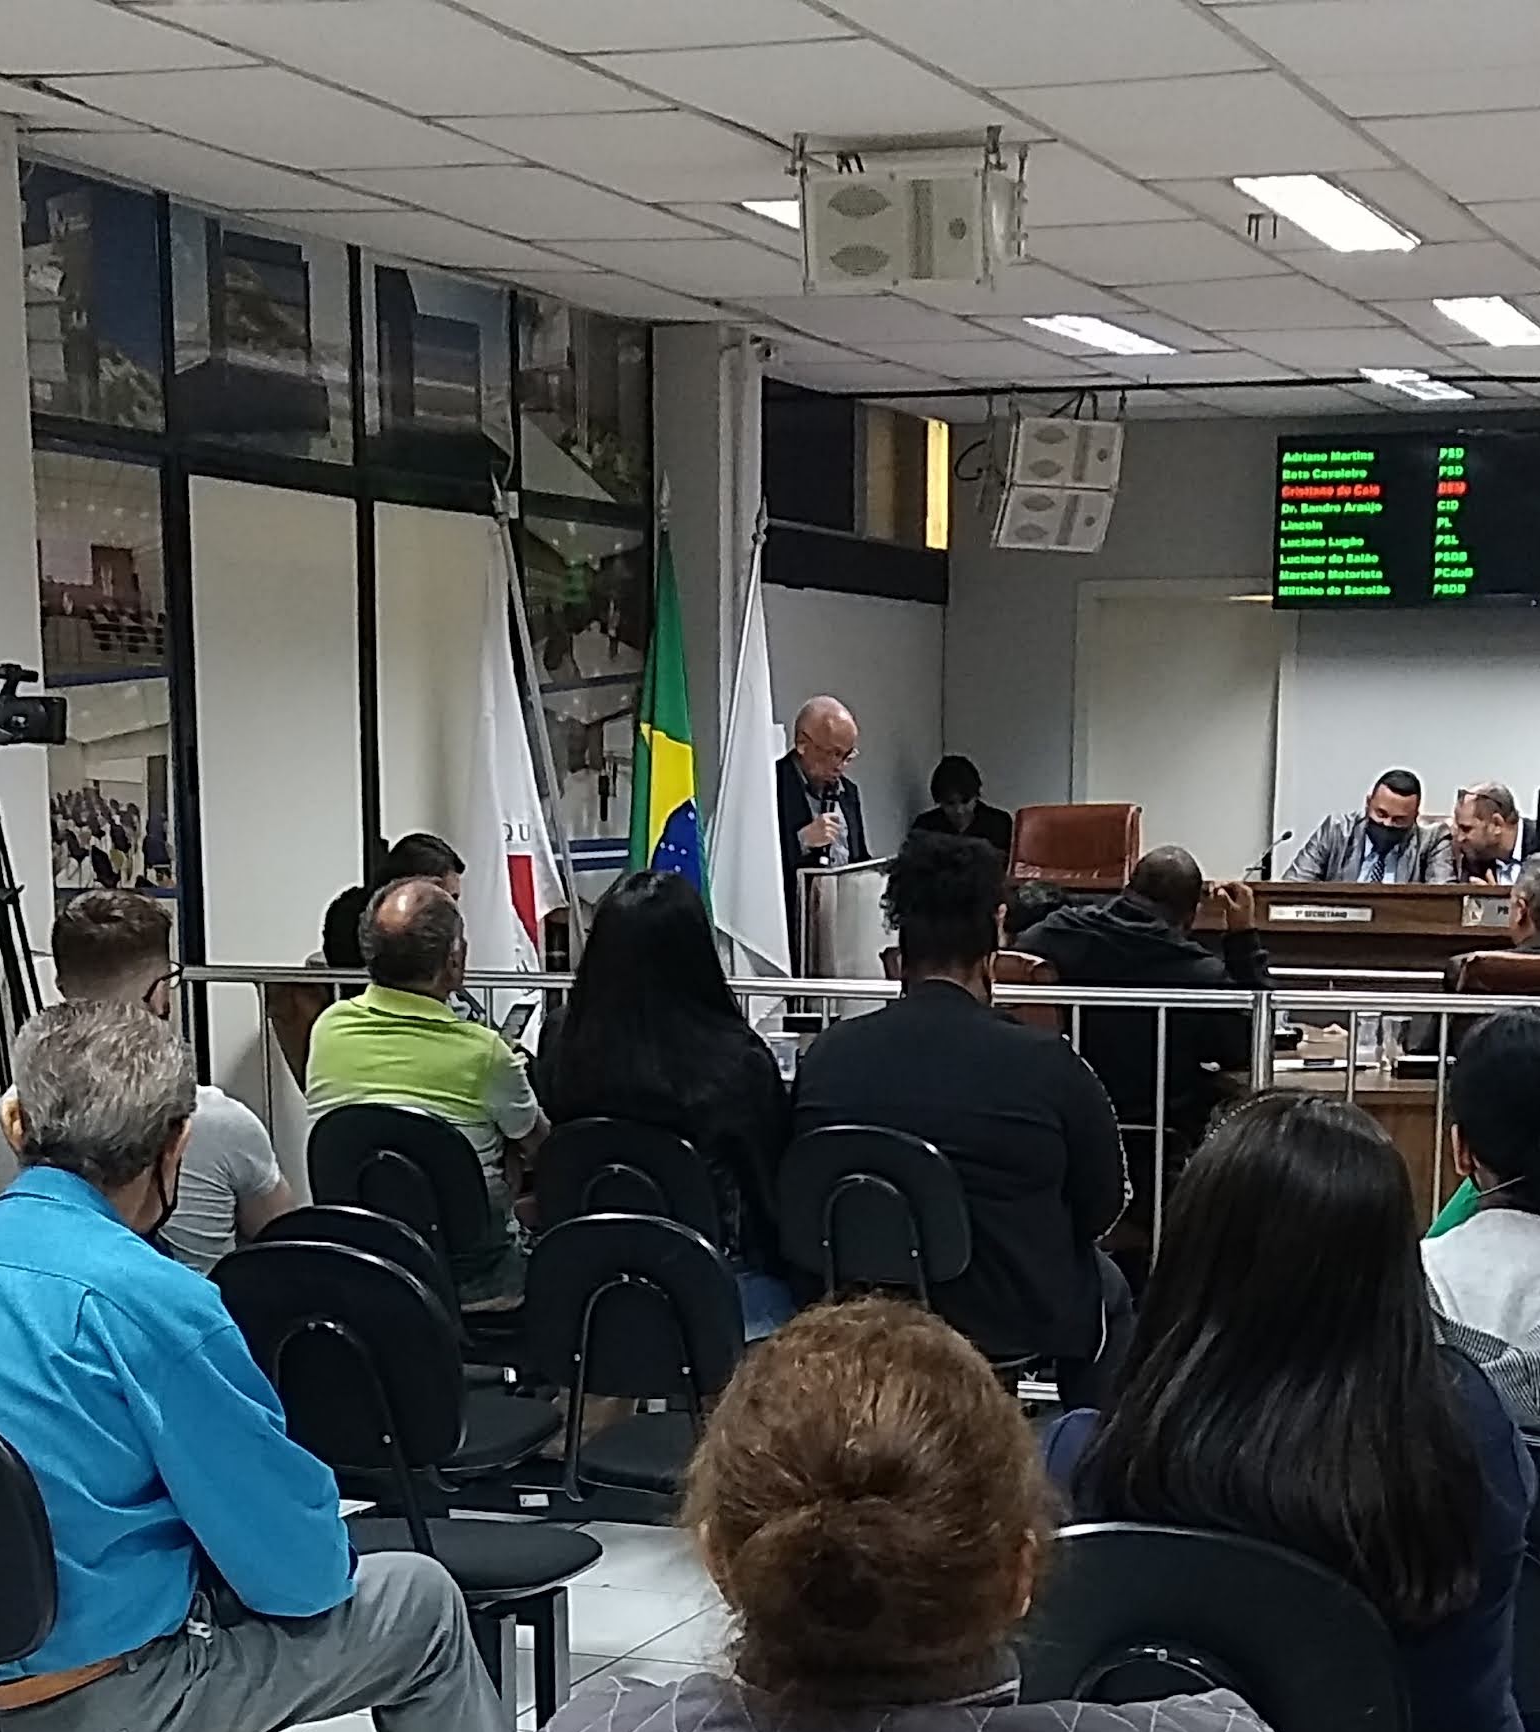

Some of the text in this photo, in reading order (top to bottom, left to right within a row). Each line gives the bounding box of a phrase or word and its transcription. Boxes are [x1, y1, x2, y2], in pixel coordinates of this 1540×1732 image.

[1283, 450, 1374, 463] Adriano Martins
[1439, 448, 1464, 460] PSD
[1282, 467, 1368, 481] Beto Cavaleiro
[1439, 466, 1464, 476] PSD
[1281, 501, 1383, 515] Dr. Sandro Araújo
[1437, 500, 1459, 511] CID
[1281, 520, 1323, 531] Lincoln
[1437, 517, 1452, 528] PL
[1280, 538, 1326, 548] Luciano
[1435, 535, 1459, 546] PSL
[1280, 554, 1327, 564] Lucimar
[1328, 554, 1344, 564] do
[1435, 552, 1467, 563] PSDB
[1279, 569, 1383, 580] Marcelo Motorista
[1435, 568, 1474, 578] PCdoB
[1278, 585, 1324, 596] Miltinho
[1327, 586, 1342, 595] do
